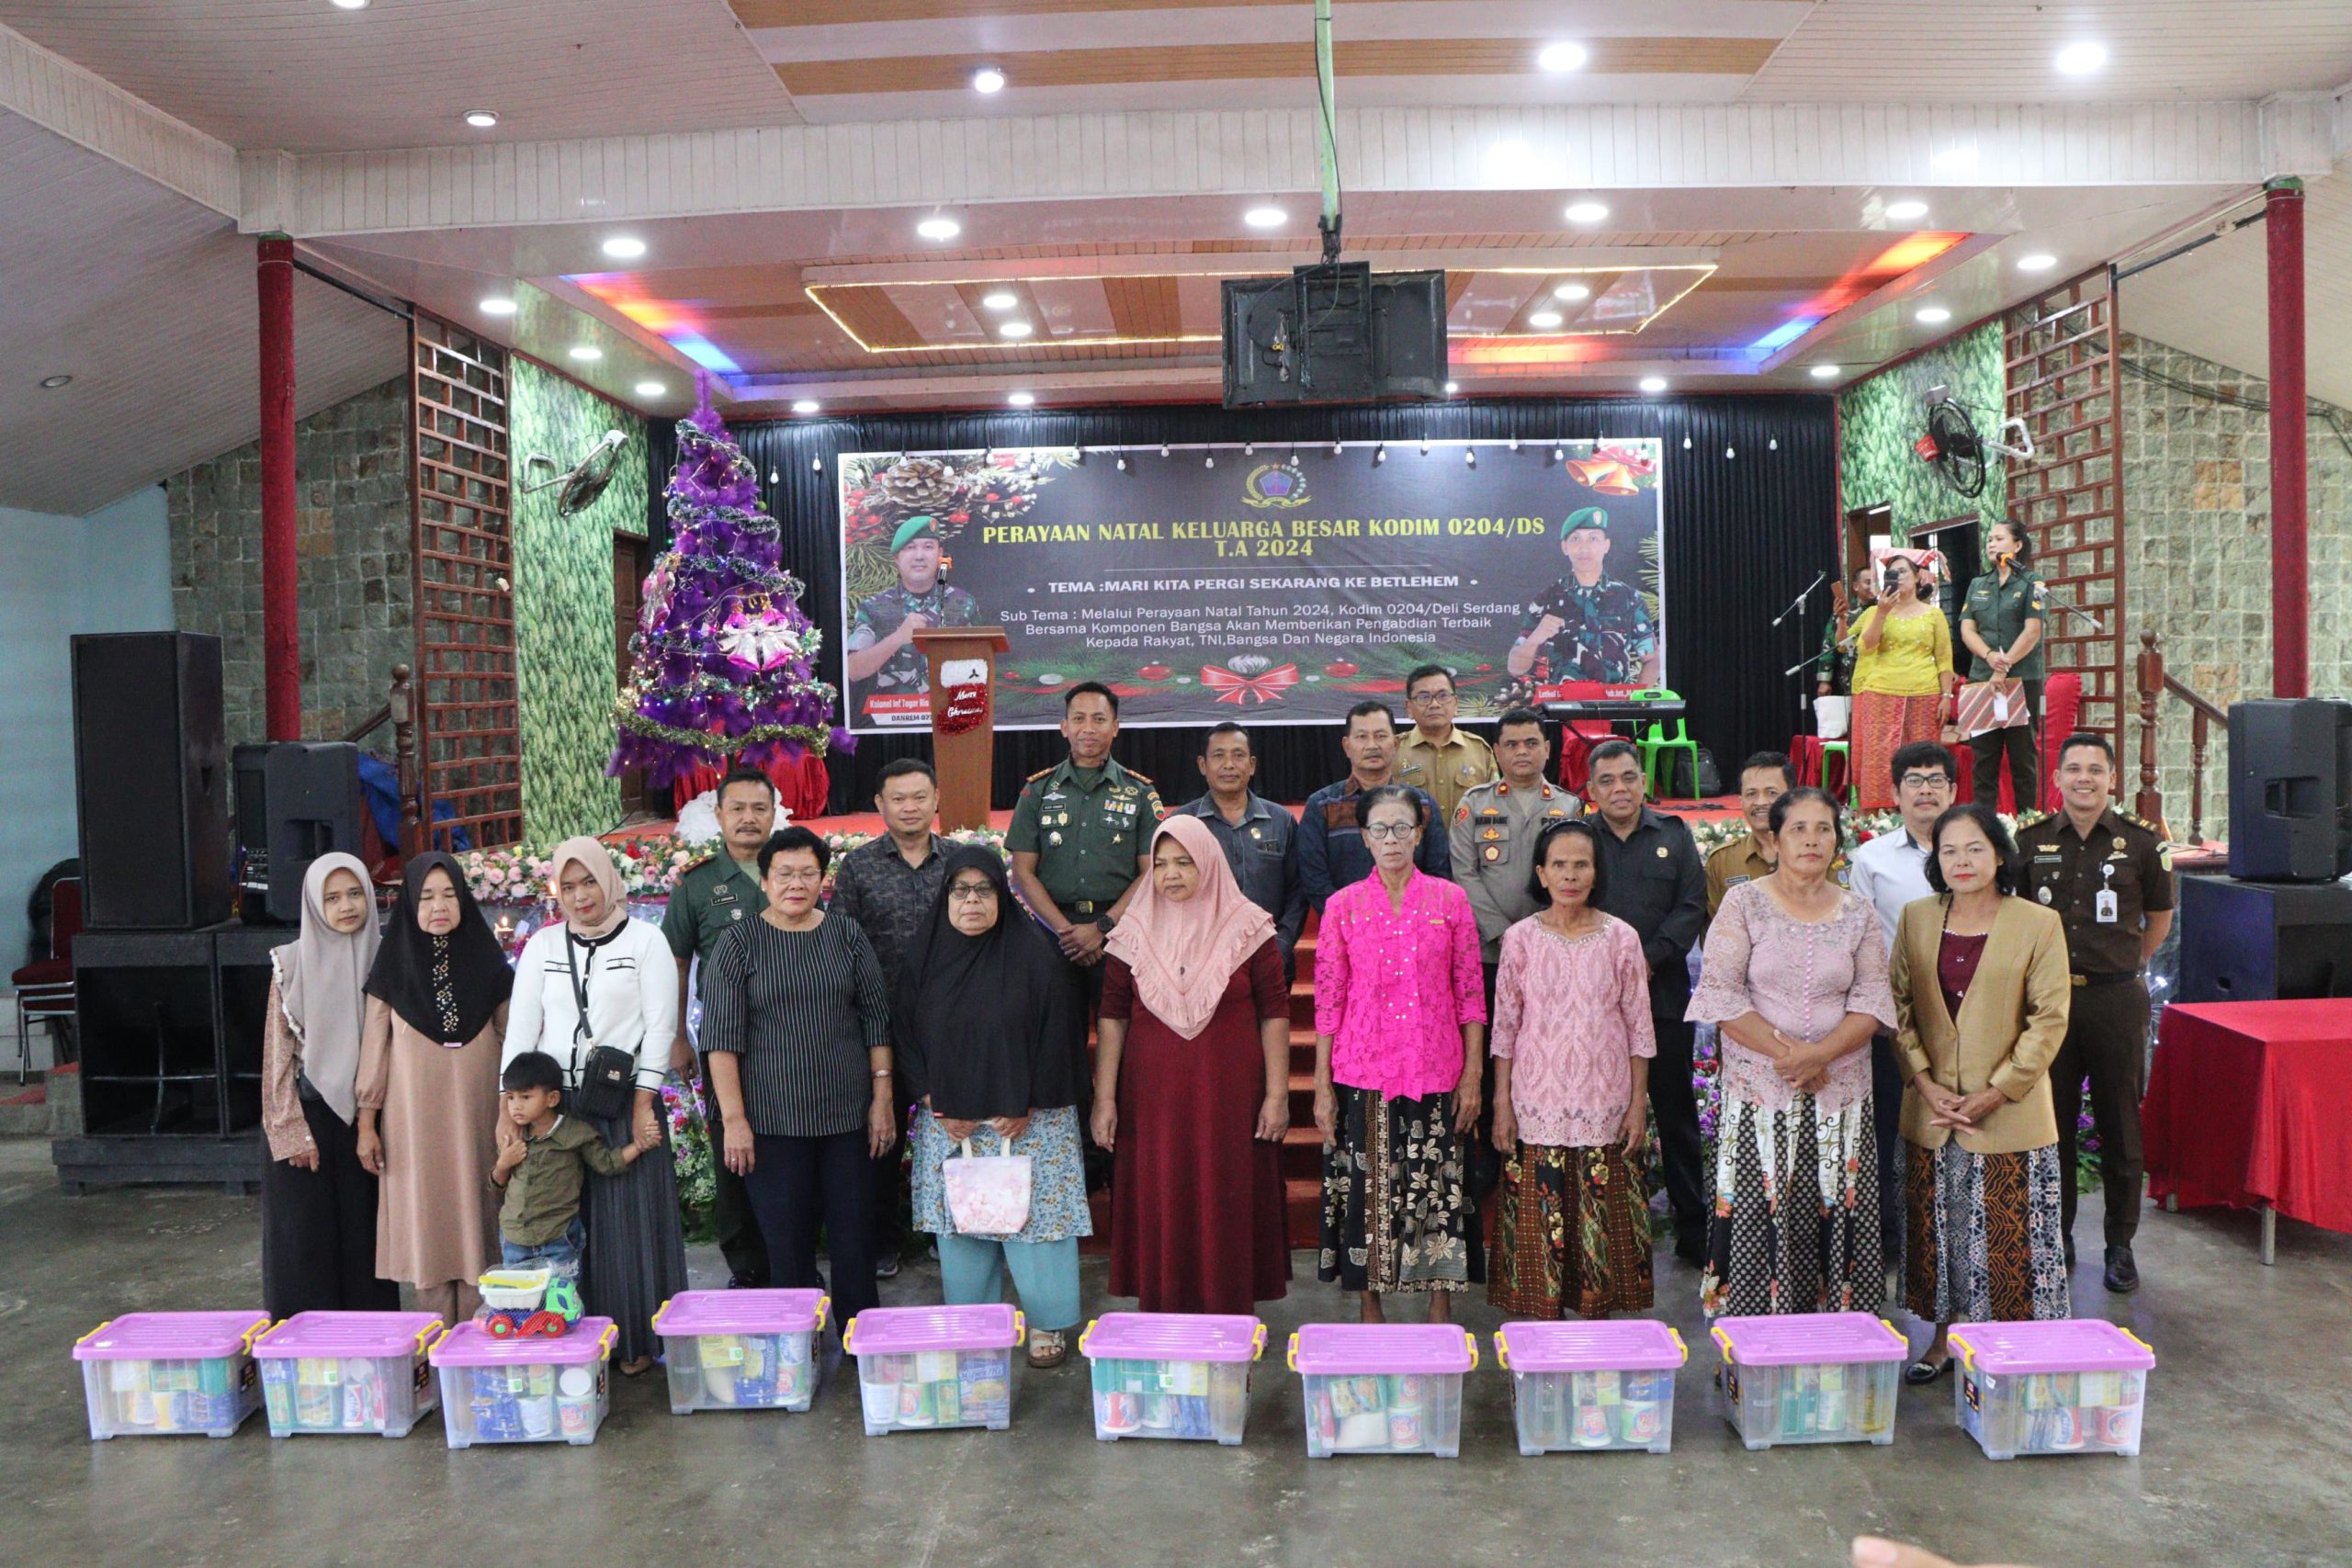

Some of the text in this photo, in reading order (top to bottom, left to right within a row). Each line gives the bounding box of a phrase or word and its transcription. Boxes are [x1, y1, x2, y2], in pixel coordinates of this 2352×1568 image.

[983, 516, 1545, 544] PERAYAAN NATAL KELUARGA BESAR KODIM 0204/DS
[1215, 538, 1314, 558] T.A 2024
[1048, 575, 1459, 593] TEMA :MARI KITA PERGI SEKARANG KE BETLEHEM
[1001, 610, 1027, 622] Sub
[1032, 609, 1069, 621] Tema
[1081, 607, 1132, 620] Melalui
[1136, 606, 1200, 621] Perayaan
[1204, 605, 1242, 617] Natal
[1246, 604, 1288, 616] Tahun
[1293, 604, 1334, 617] 2024,
[1339, 604, 1382, 615] Kodim
[1386, 603, 1459, 615] 0204/Deli
[1463, 602, 1521, 616] Serdang
[1025, 617, 1492, 636] Bersama Komponen Bangsa Akan Memberikan Pengabdian Terbaik
[1086, 637, 1138, 649] Kepada
[1143, 635, 1195, 649] Rakyat,
[1283, 633, 1310, 645] Dan
[1315, 633, 1364, 646] Negara
[1369, 631, 1436, 644] Indonesia
